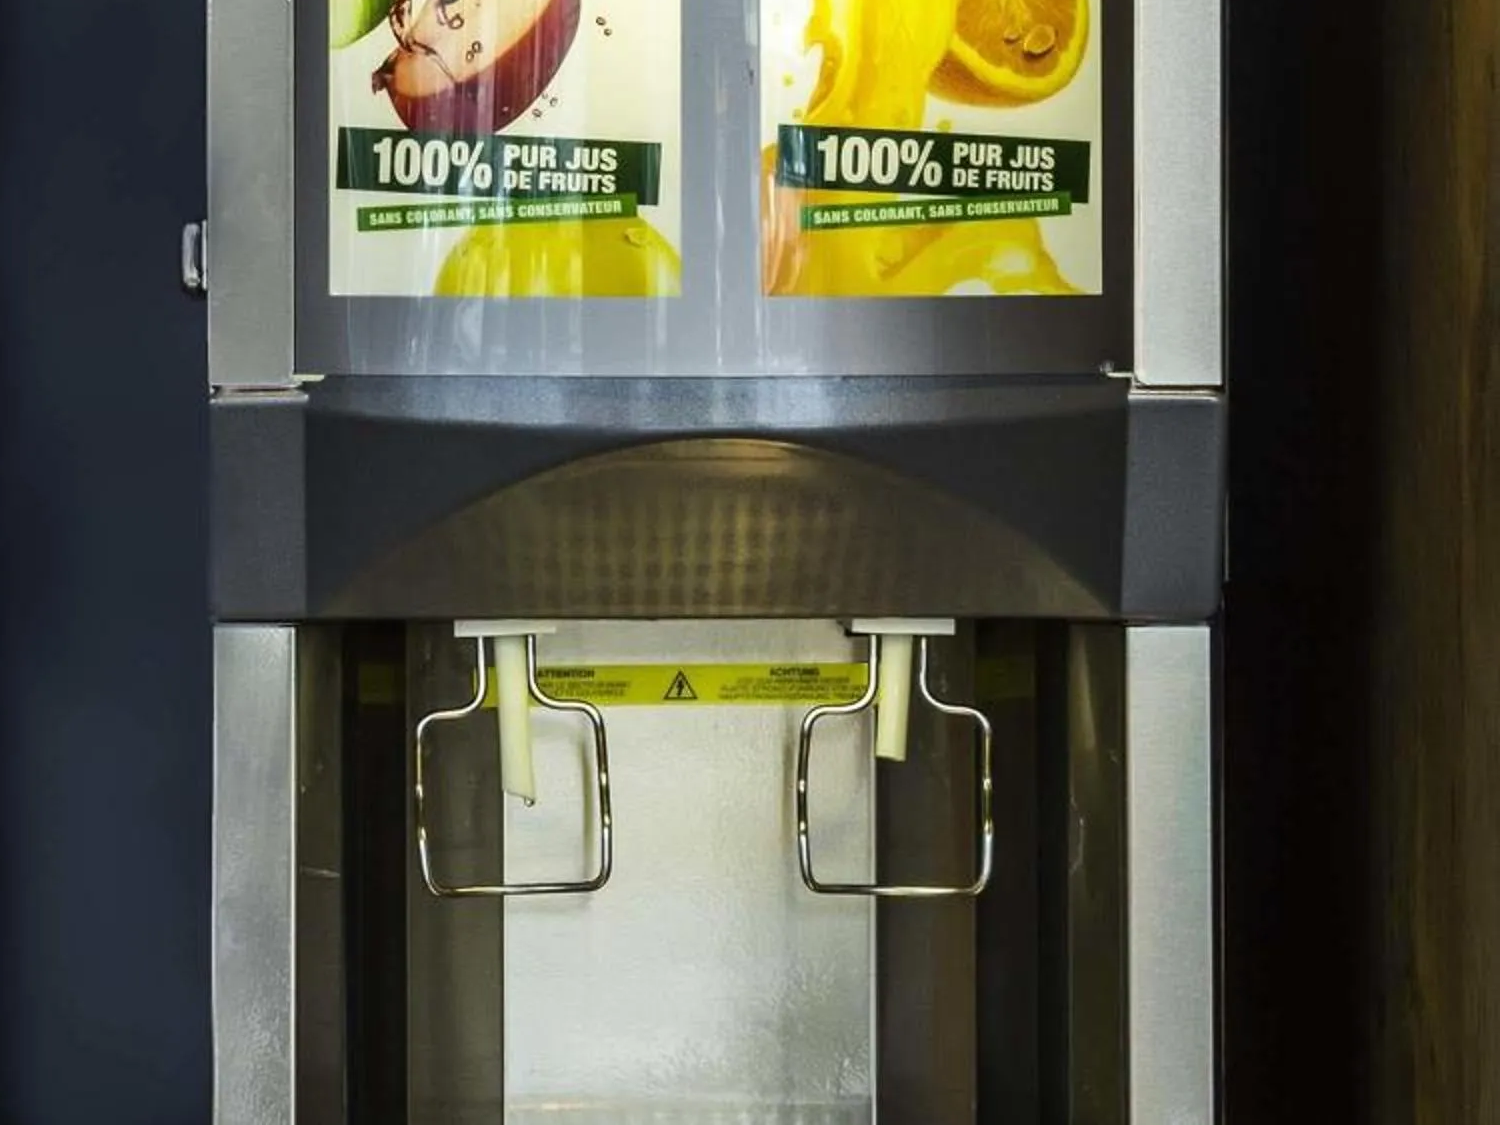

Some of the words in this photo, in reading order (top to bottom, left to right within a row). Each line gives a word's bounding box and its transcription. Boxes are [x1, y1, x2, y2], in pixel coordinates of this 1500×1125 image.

[373, 137, 493, 189] 100%
[503, 143, 556, 169] PUR
[565, 146, 618, 172] JUS
[817, 134, 942, 187] 100%
[953, 142, 1001, 167] PUR
[1009, 144, 1055, 170] JUS
[502, 170, 531, 190] DE
[539, 172, 617, 194] FRUITS
[952, 168, 979, 188] DE
[985, 169, 1054, 192] FRUITS
[369, 210, 403, 226] SANS
[479, 203, 515, 221] SANS
[813, 209, 850, 225] SANS
[929, 202, 964, 219] SANS
